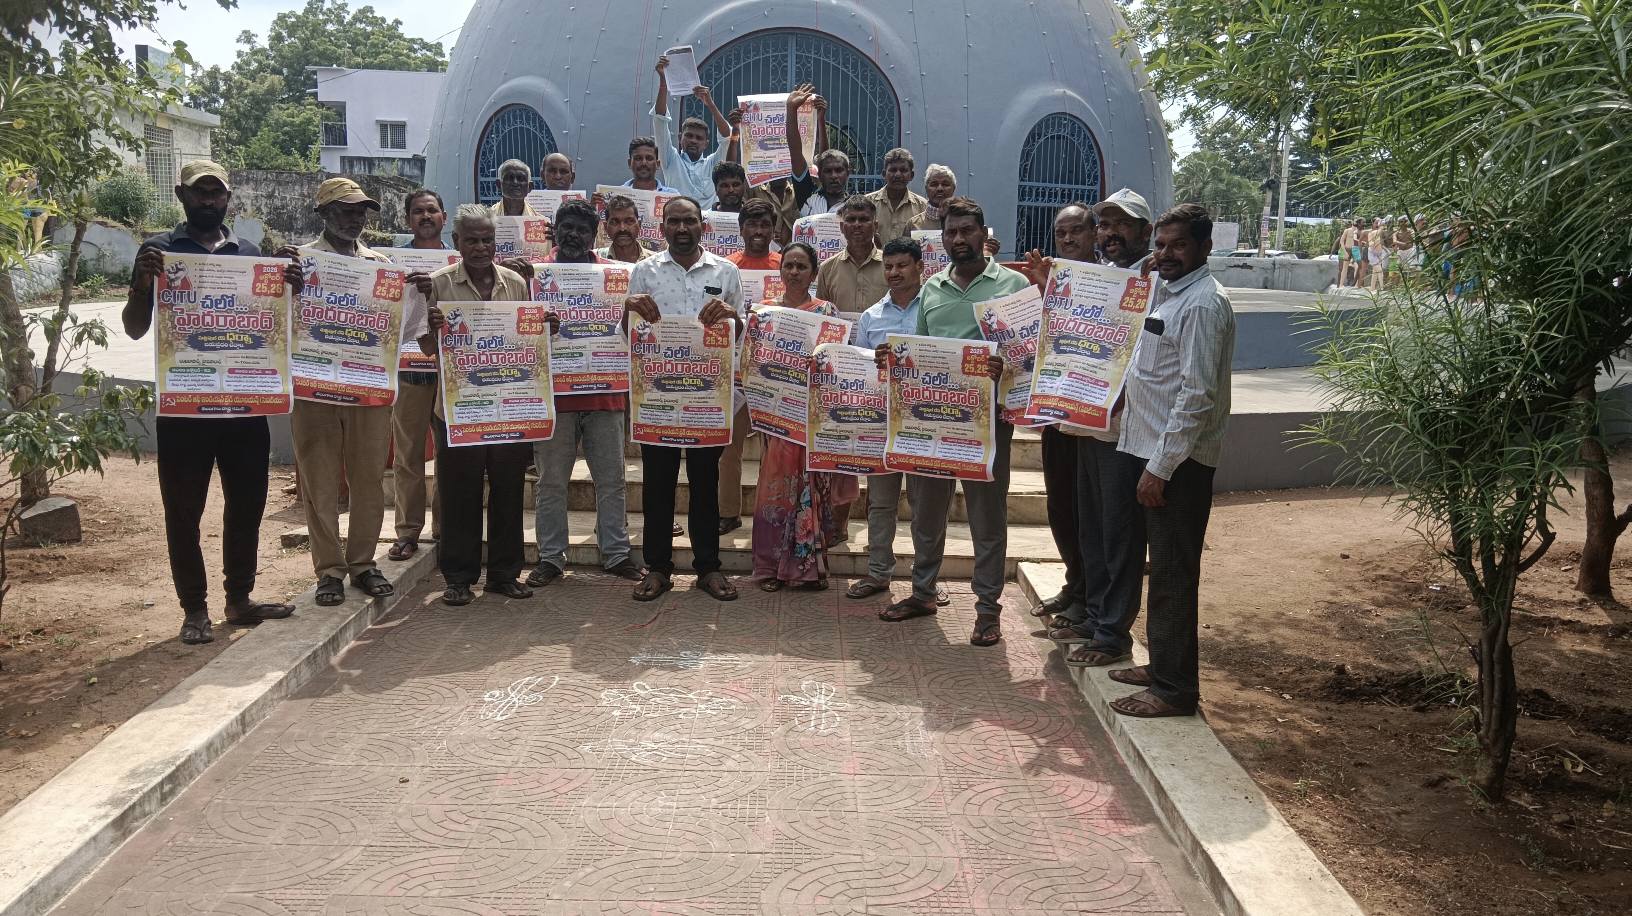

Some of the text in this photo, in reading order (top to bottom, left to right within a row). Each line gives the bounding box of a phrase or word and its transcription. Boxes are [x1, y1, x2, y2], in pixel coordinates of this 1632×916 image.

[743, 112, 763, 122] CITU
[701, 232, 716, 241] ITU
[922, 252, 937, 261] ITU
[256, 283, 282, 295] 25,26
[301, 284, 323, 299] ITU
[375, 285, 401, 299] 25,26
[606, 282, 628, 291] 25,26
[160, 289, 197, 304] CITU
[537, 292, 564, 302] CITU
[1045, 296, 1073, 310] CITU
[1122, 296, 1147, 309] 25,26
[173, 308, 275, 333] హైదరాబాద్
[302, 300, 391, 332] హైదరాబాద్
[519, 322, 543, 332] 25,26
[1048, 313, 1130, 345] హైదరాబాద్
[444, 334, 473, 347] CITU
[705, 337, 728, 346] 25,26
[749, 328, 776, 342] CITU
[633, 343, 661, 355] CITU
[453, 348, 537, 372] హైదరాబాద్
[643, 357, 721, 378] హైదరాబాద్
[893, 367, 919, 379] CITU
[812, 373, 838, 385] CITU
[901, 382, 980, 407] హైదరాబాద్
